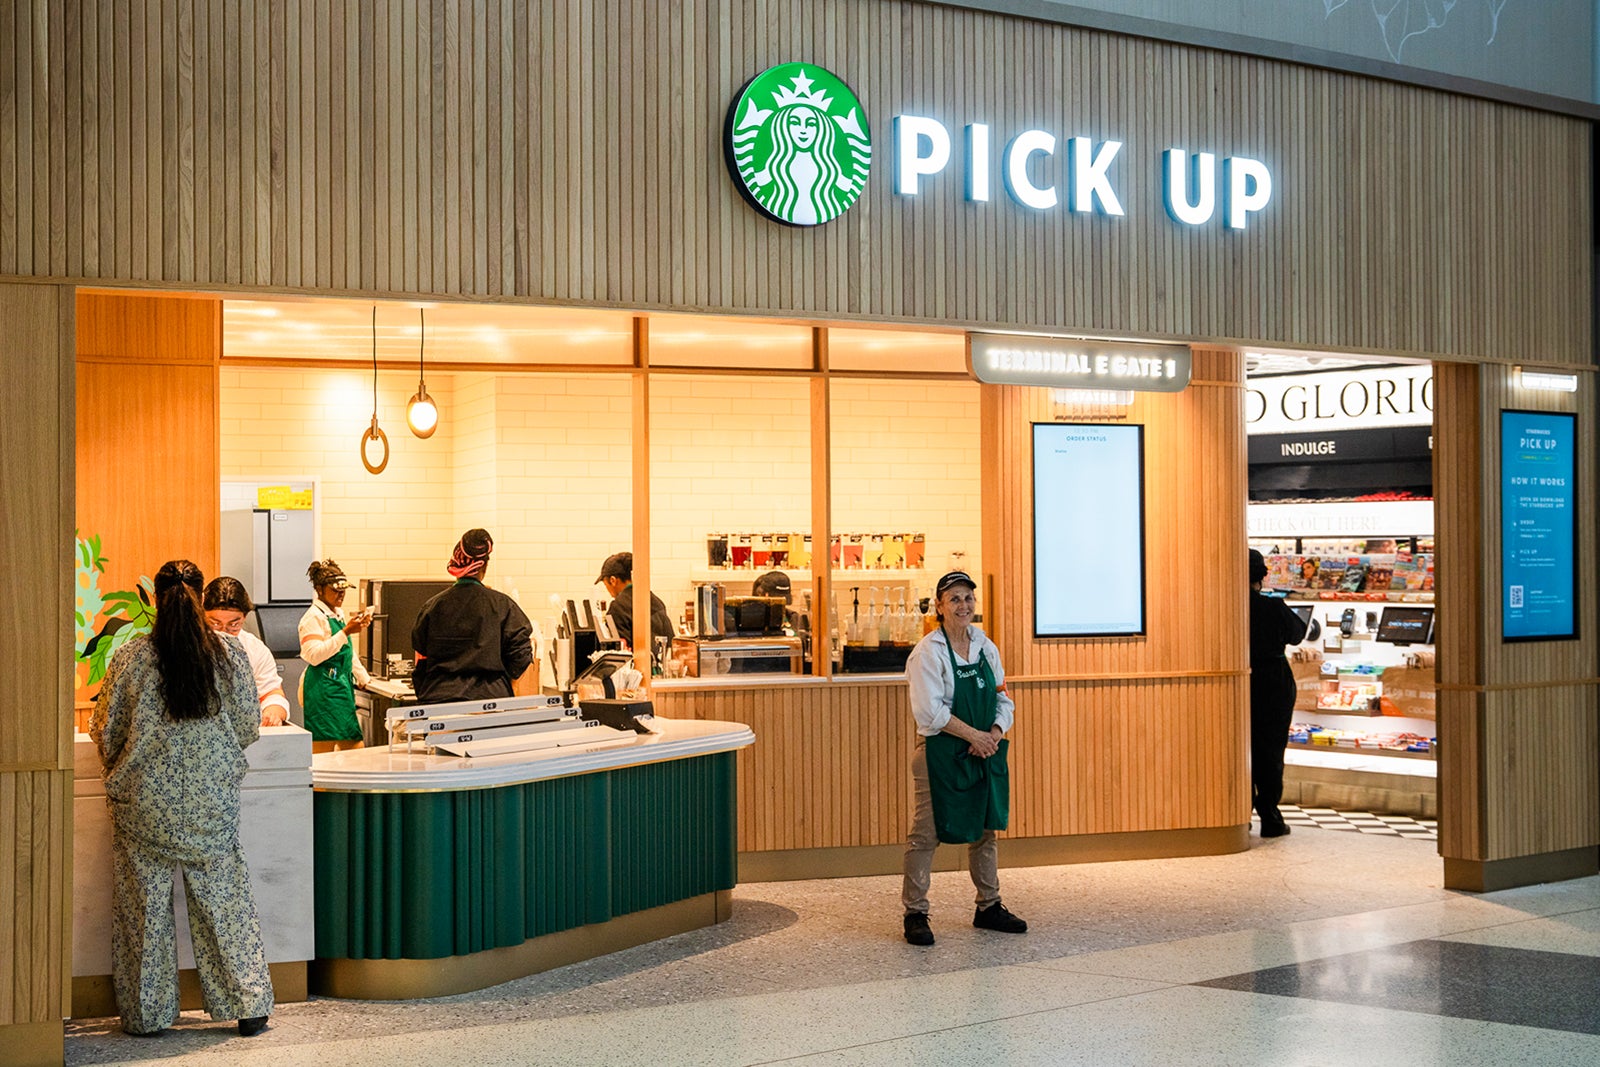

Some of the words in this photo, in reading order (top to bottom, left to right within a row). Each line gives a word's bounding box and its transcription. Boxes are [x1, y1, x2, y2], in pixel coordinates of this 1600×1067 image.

[895, 114, 1125, 217] PICK
[1163, 147, 1273, 230] UP
[986, 347, 1091, 374] TERMINAL
[1095, 355, 1109, 375] E
[1110, 354, 1162, 378] GATE
[1165, 359, 1176, 378] 1
[1281, 441, 1336, 456] INDULGE
[1520, 438, 1541, 449] PICK
[1544, 439, 1557, 450] UP
[1511, 477, 1528, 485] HOW
[1530, 477, 1538, 485] IT
[1540, 478, 1565, 486] WORKS
